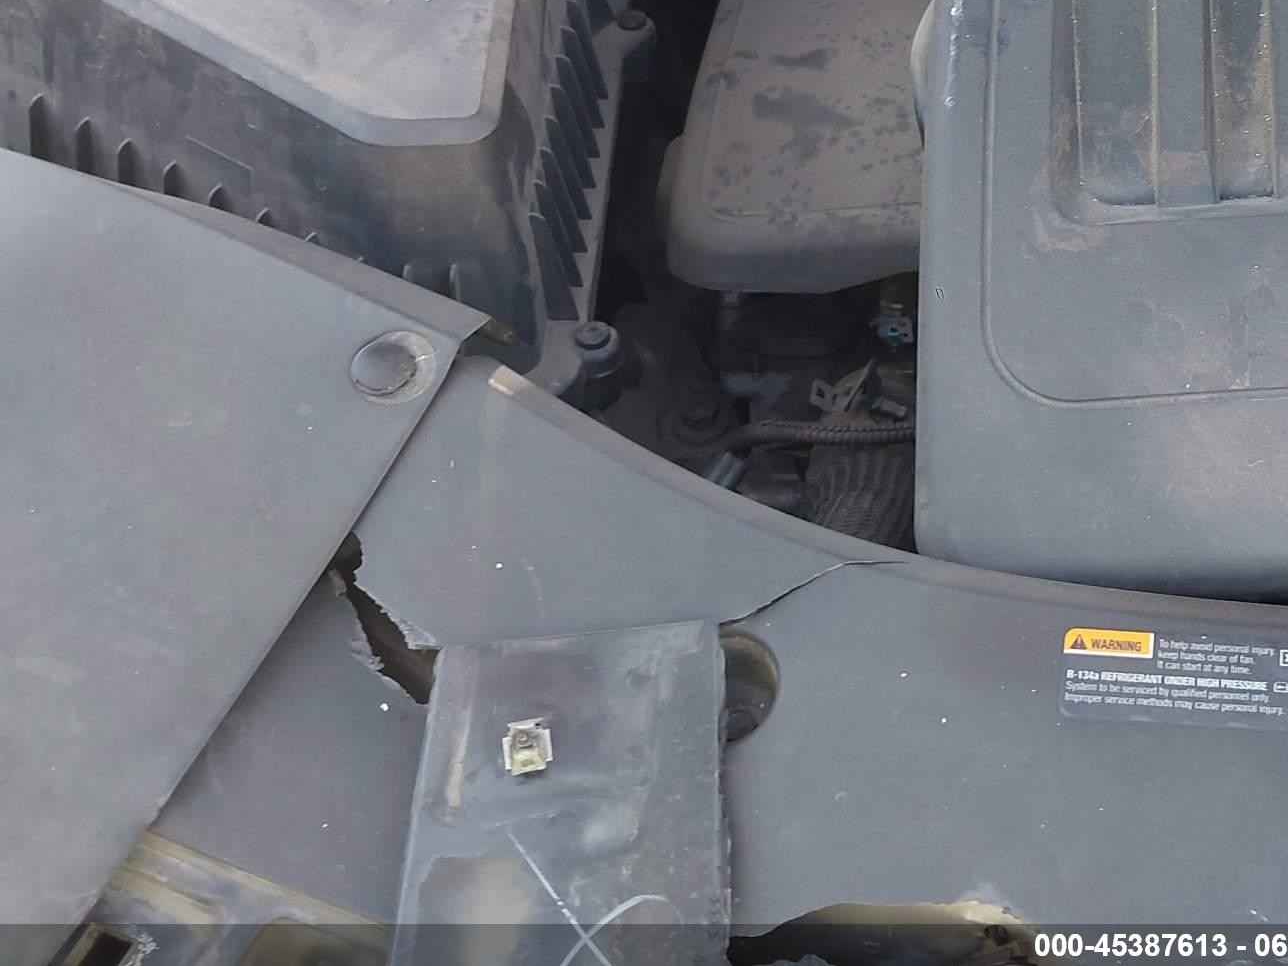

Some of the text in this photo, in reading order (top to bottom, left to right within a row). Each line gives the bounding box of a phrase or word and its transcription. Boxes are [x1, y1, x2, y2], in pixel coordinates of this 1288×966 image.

[1091, 638, 1142, 652] WARNING
[1160, 639, 1170, 648] To
[1170, 640, 1189, 650] help
[1190, 642, 1213, 651] avoid
[1214, 644, 1250, 653] personal
[1158, 650, 1180, 660] keep
[1180, 652, 1206, 661] hands
[1207, 654, 1227, 662] clear
[1228, 654, 1238, 663] of
[1182, 662, 1201, 671] start
[1203, 664, 1212, 672] at
[1213, 665, 1229, 674] any
[1230, 665, 1251, 674] time.
[1066, 669, 1268, 691] R-134a REFRIGERANT UNDER HIGH PRESSURE
[1065, 680, 1098, 691] System
[1099, 683, 1108, 691] to
[1109, 684, 1120, 692] be
[1122, 685, 1157, 695] serviced
[1159, 687, 1169, 697] by
[1170, 688, 1207, 698] qualified
[1208, 691, 1250, 700] personnel
[1064, 692, 1103, 703] Improper
[1104, 696, 1135, 705] service
[1136, 697, 1173, 707] methods
[1174, 700, 1193, 710] may
[1194, 701, 1220, 710] cause
[1221, 703, 1258, 713] personal
